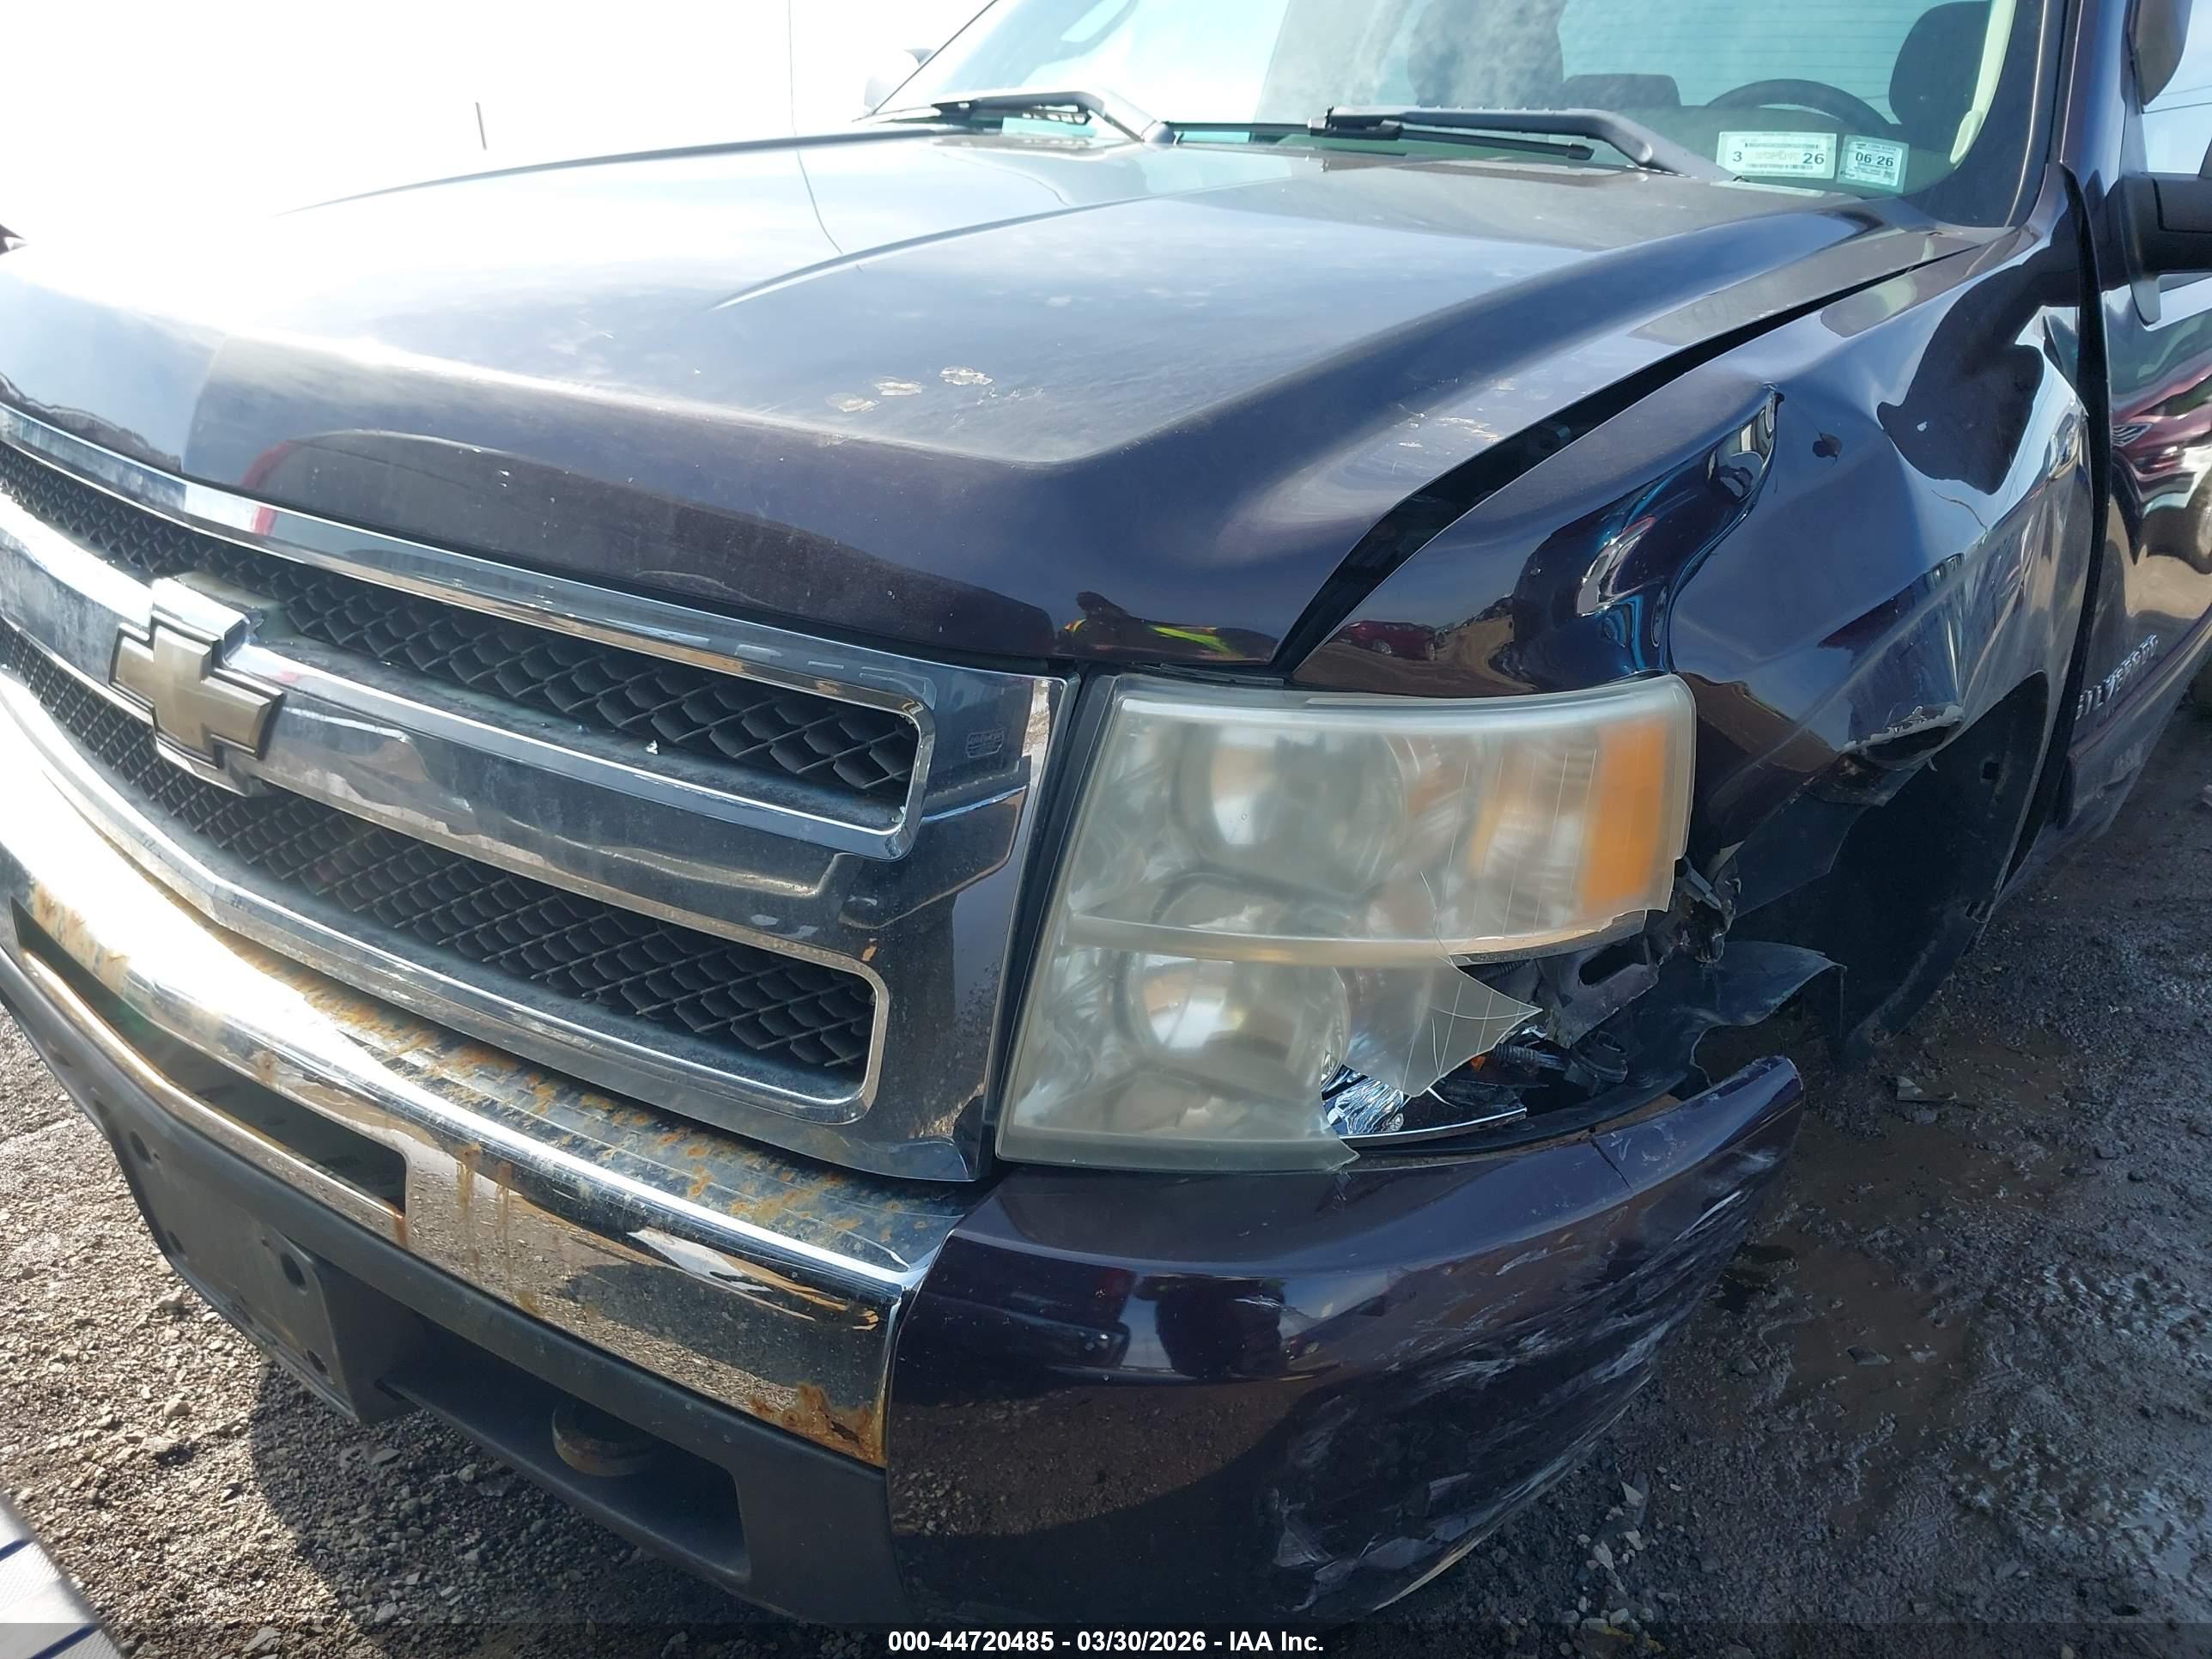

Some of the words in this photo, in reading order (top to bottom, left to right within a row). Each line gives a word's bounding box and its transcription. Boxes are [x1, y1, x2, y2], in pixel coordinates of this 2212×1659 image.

[1732, 150, 1743, 162] 3
[1802, 152, 1825, 165] 26
[1855, 151, 1872, 164] 06
[1876, 155, 1894, 167] 26
